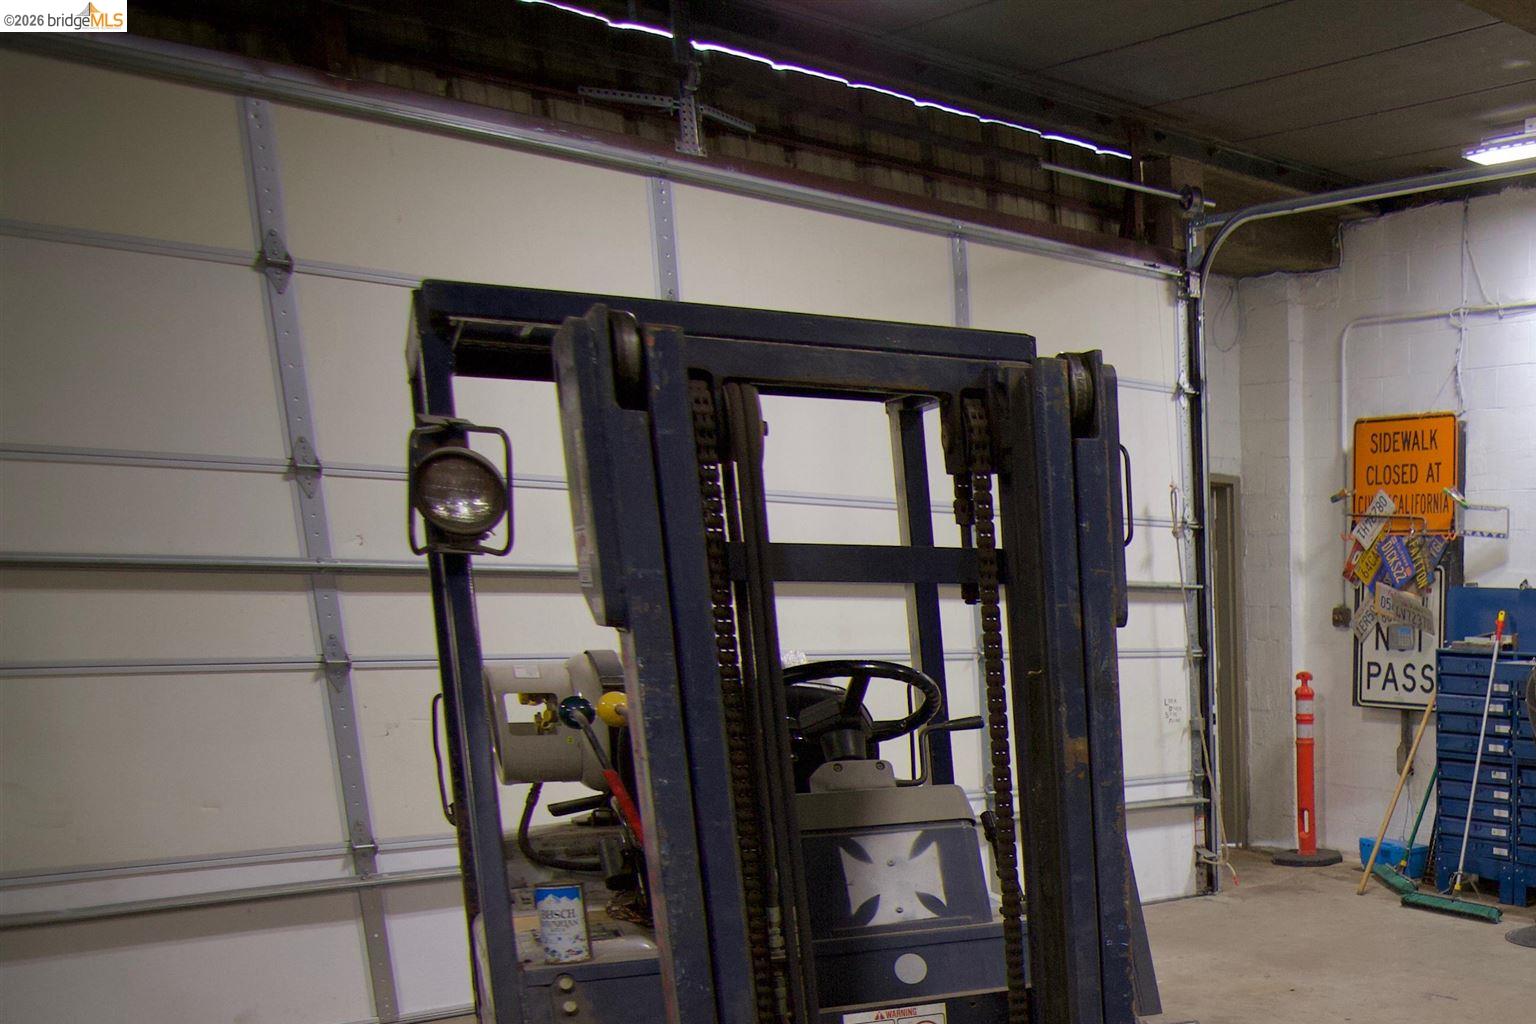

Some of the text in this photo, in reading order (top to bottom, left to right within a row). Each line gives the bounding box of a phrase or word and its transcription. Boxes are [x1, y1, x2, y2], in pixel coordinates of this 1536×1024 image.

[1370, 429, 1438, 454] SIDEWALK
[1366, 462, 1442, 486] CLOSED AT
[1392, 493, 1450, 514] CALIFORNIA
[1367, 661, 1435, 694] PASS
[886, 1007, 917, 1019] WARNING
